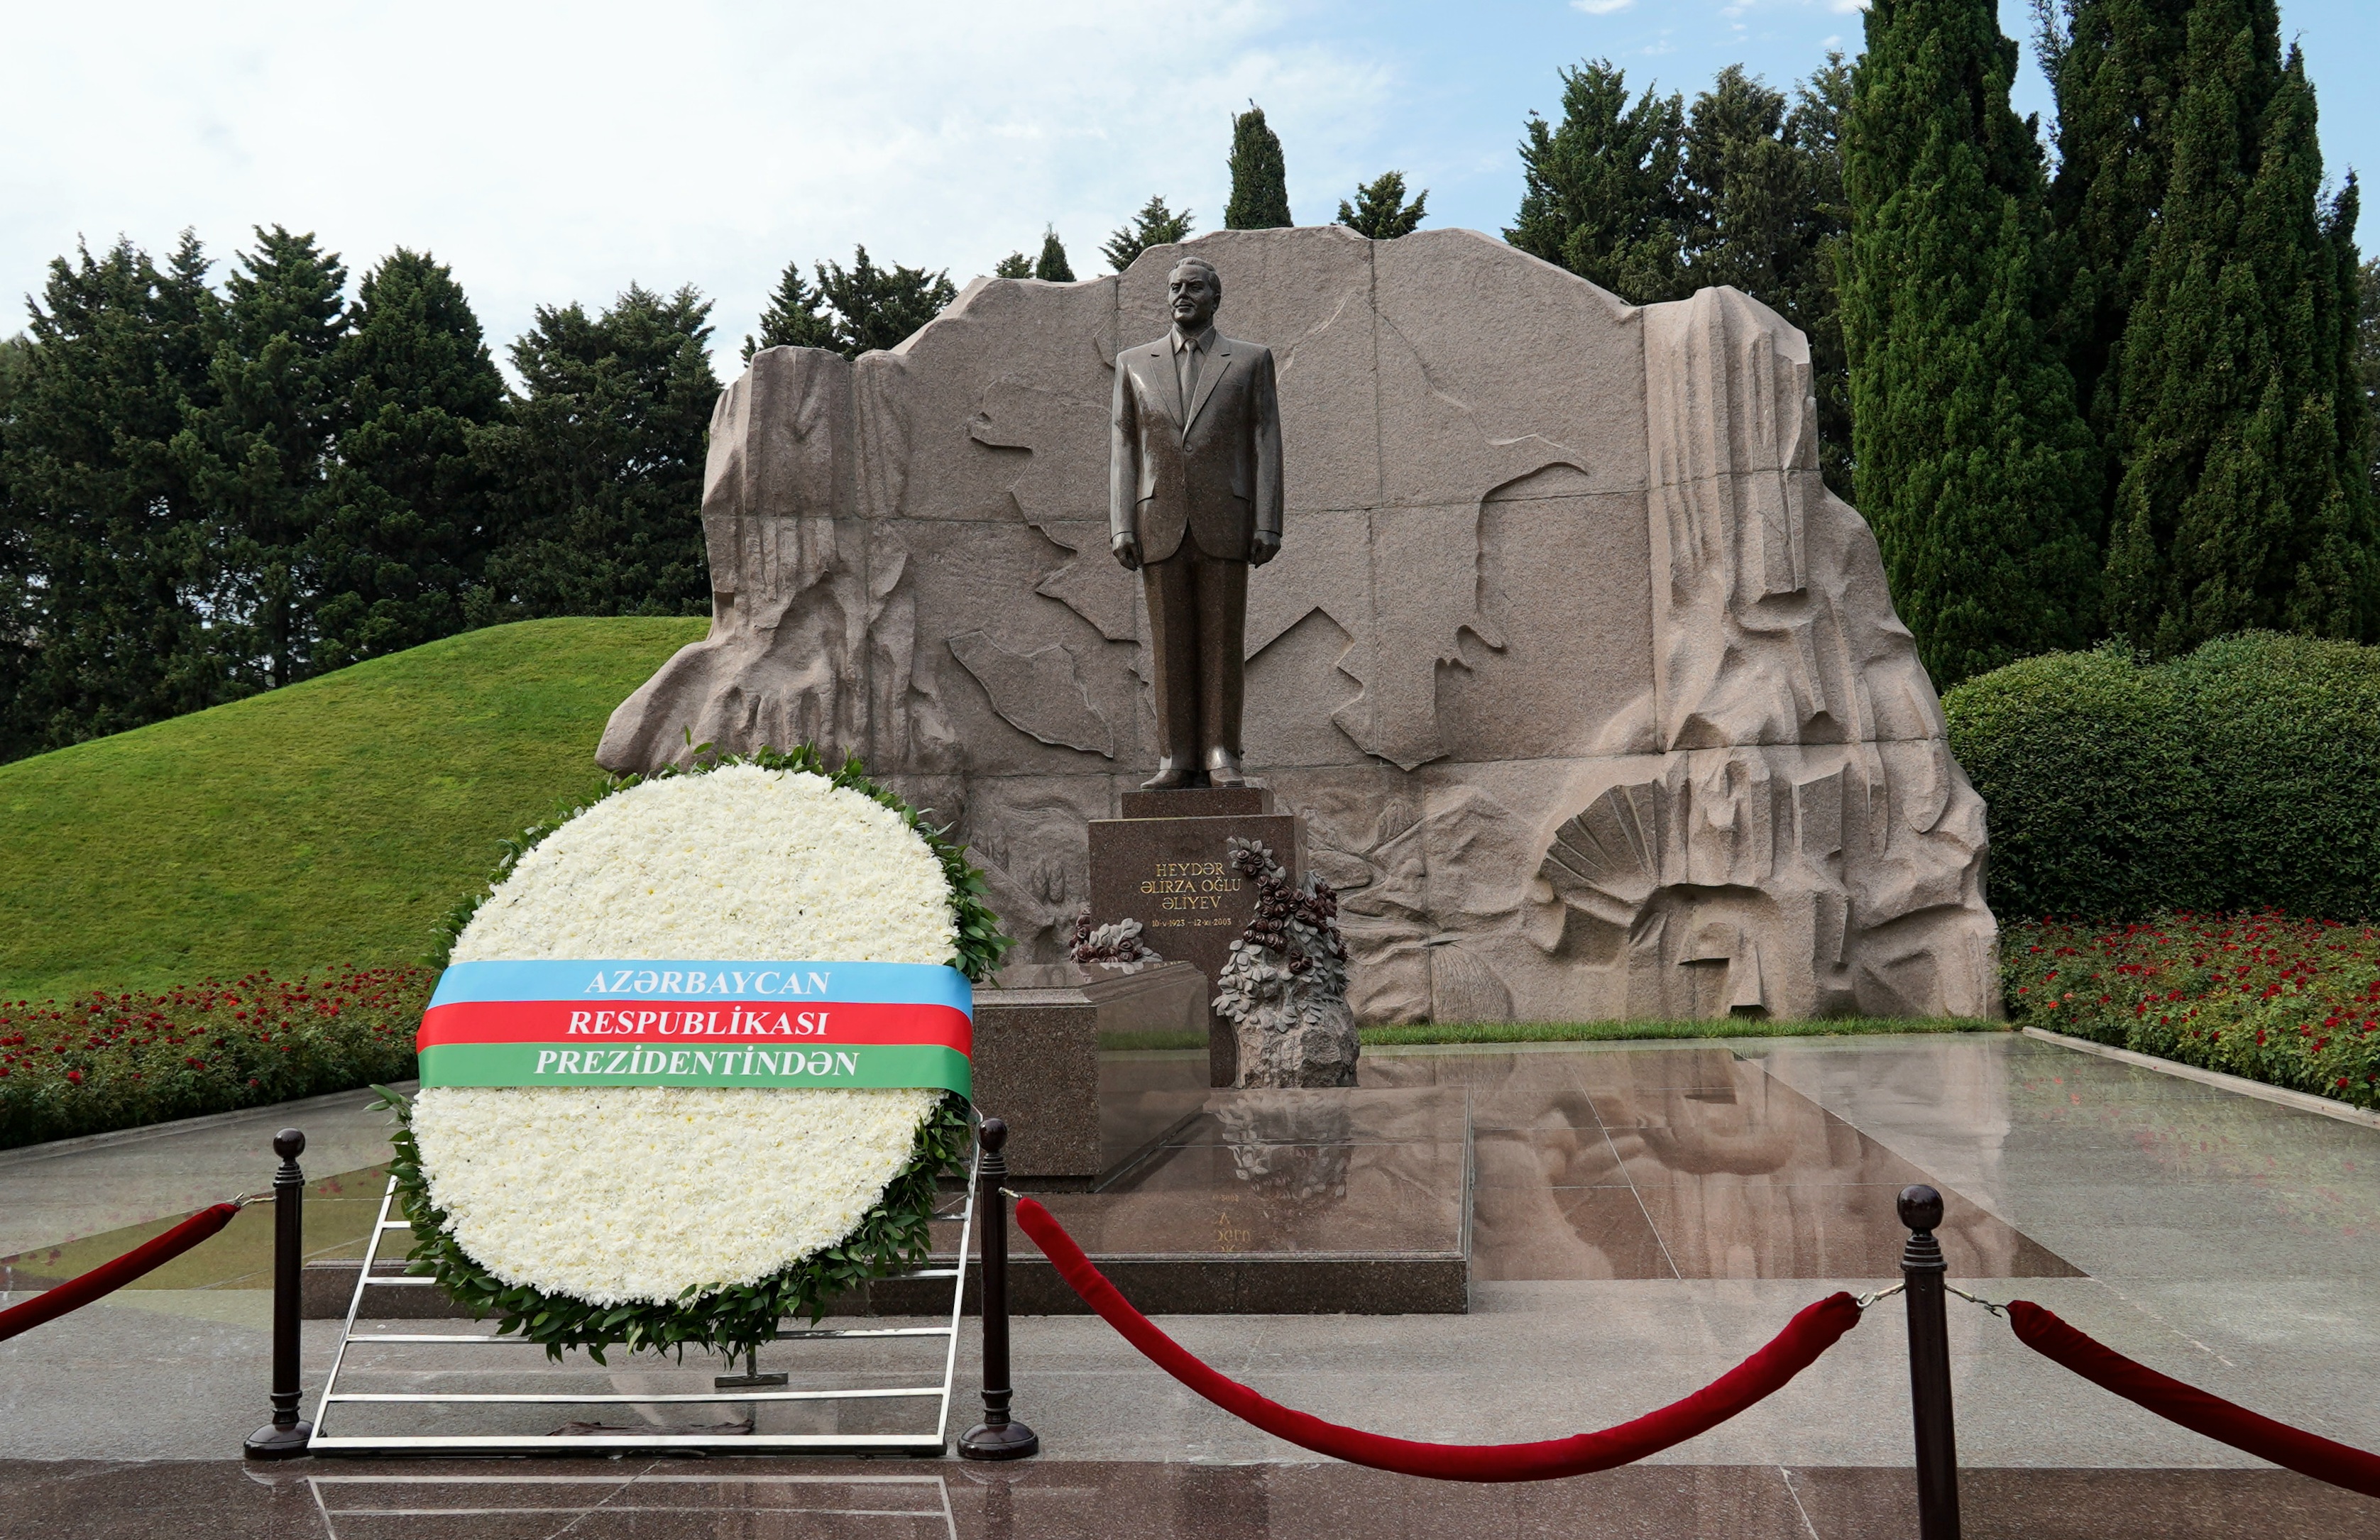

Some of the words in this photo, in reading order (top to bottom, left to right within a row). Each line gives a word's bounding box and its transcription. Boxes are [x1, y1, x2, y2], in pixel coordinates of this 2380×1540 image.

[1156, 862, 1225, 877] HEYDƏR
[1140, 879, 1196, 893] ƏLİRZA
[1201, 876, 1241, 892] OĞLU
[1162, 896, 1222, 910] ƏLİYEV
[583, 969, 831, 995] AZƏRBAYCAN
[566, 1006, 829, 1036] RESPUBLİKASI
[534, 1044, 860, 1077] PREZİDENTİNDƏN
